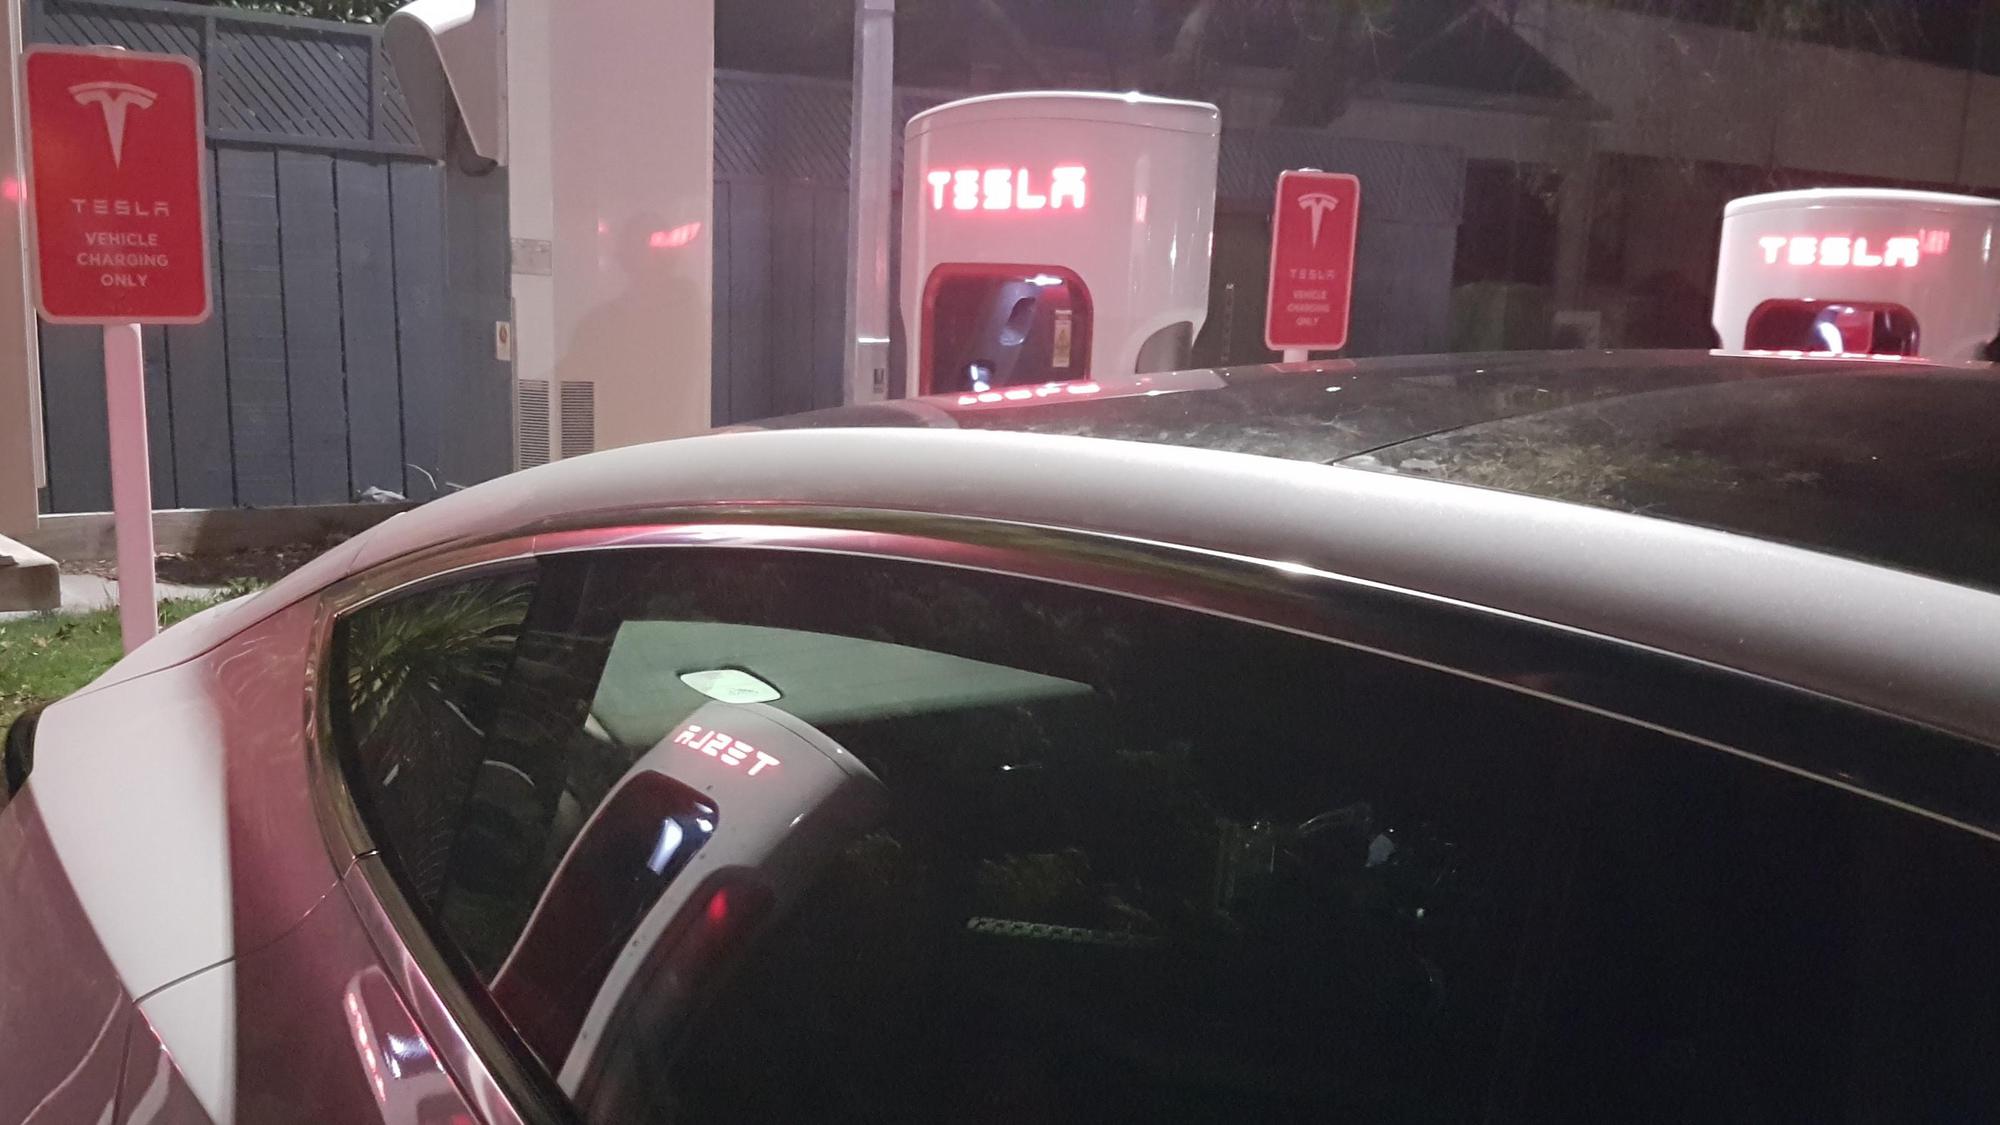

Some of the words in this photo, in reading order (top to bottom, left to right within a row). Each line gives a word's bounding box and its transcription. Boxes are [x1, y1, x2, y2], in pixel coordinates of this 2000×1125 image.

[927, 166, 1087, 211] TESLA
[71, 199, 169, 216] TESLA
[85, 232, 158, 246] VEHICLE
[1759, 236, 1920, 267] TESLA
[77, 253, 168, 267] CHARGING
[100, 274, 148, 287] ONLY
